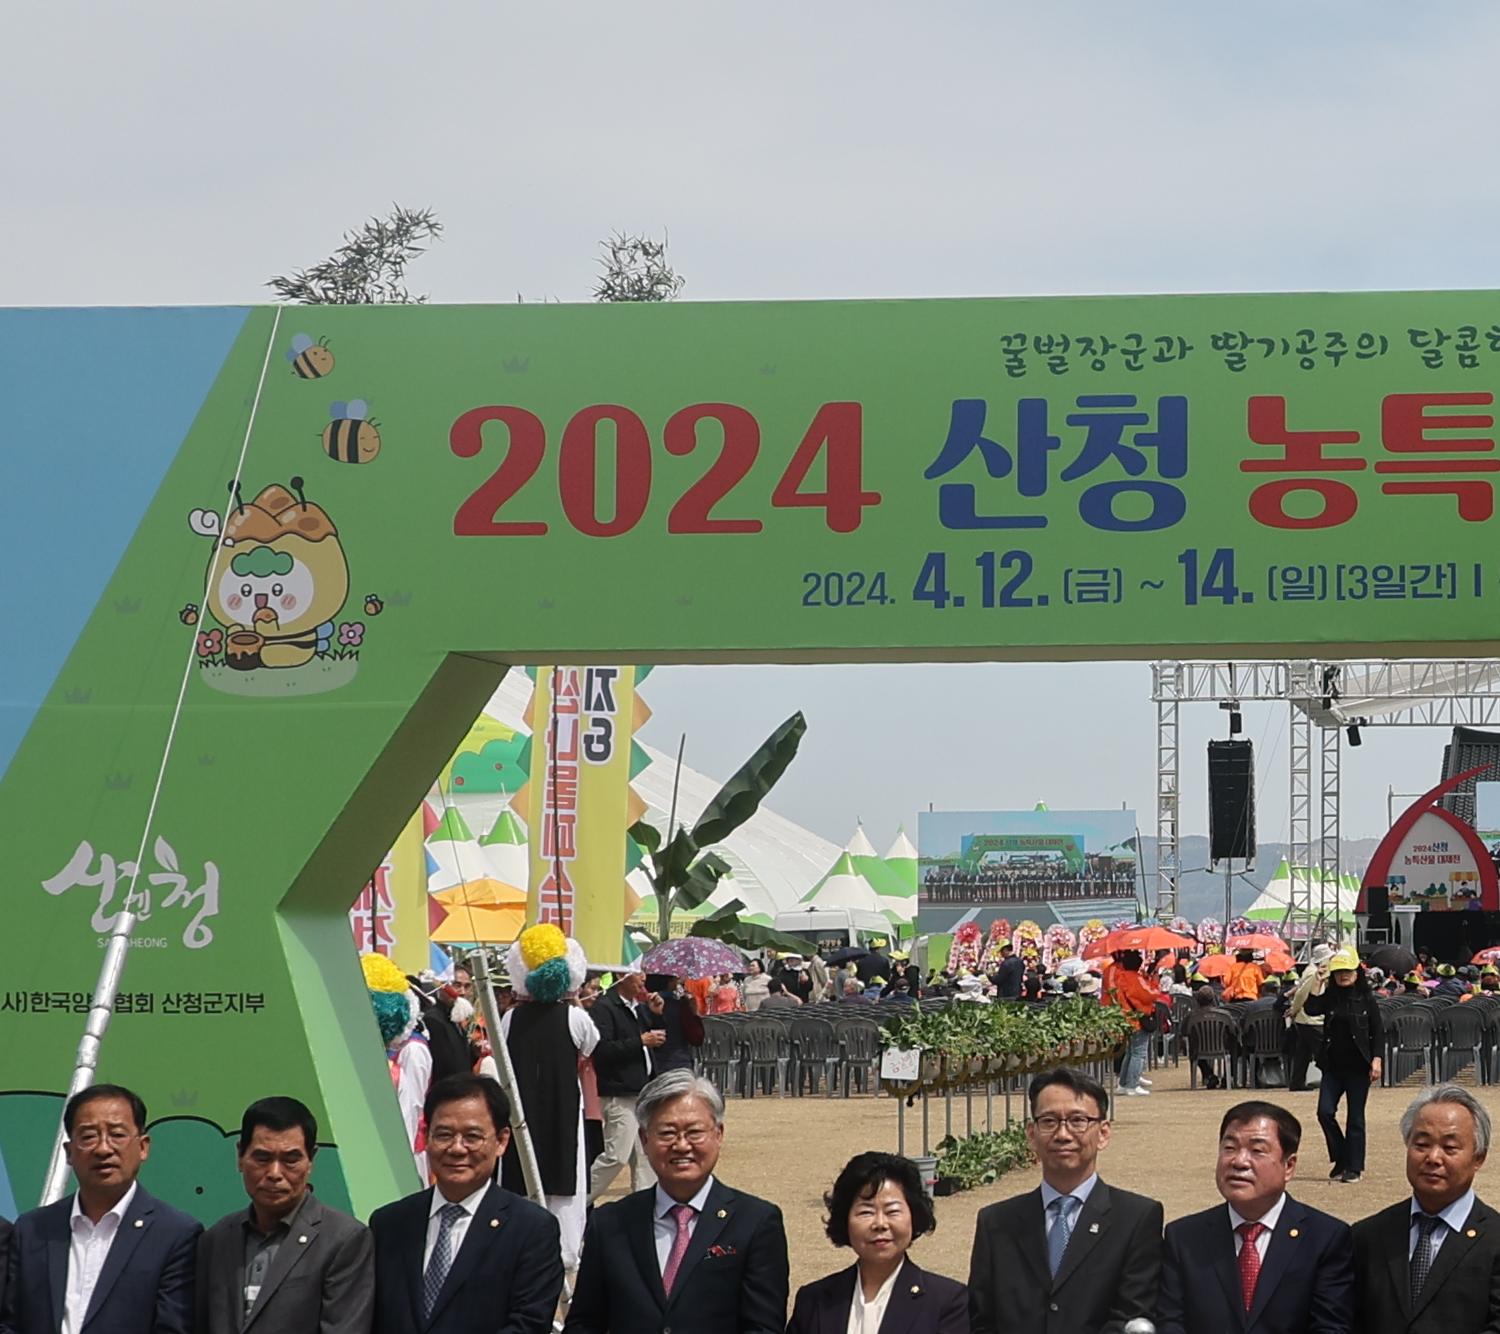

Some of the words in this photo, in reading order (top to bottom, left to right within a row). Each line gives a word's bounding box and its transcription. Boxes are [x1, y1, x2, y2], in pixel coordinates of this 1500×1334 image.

[1000, 331, 1194, 378] 꿀벌장군과
[1210, 327, 1389, 373] 딸기공주의
[447, 400, 883, 538] 2024
[923, 393, 1189, 533] 산청
[802, 571, 896, 607] 2024.
[911, 549, 1050, 610] 4.12.
[1063, 567, 1123, 605] (금)
[1177, 547, 1255, 607] 14.
[1404, 854, 1436, 865] 농특산물
[129, 937, 168, 948] HEONG
[161, 990, 266, 1015] 산청군지부
